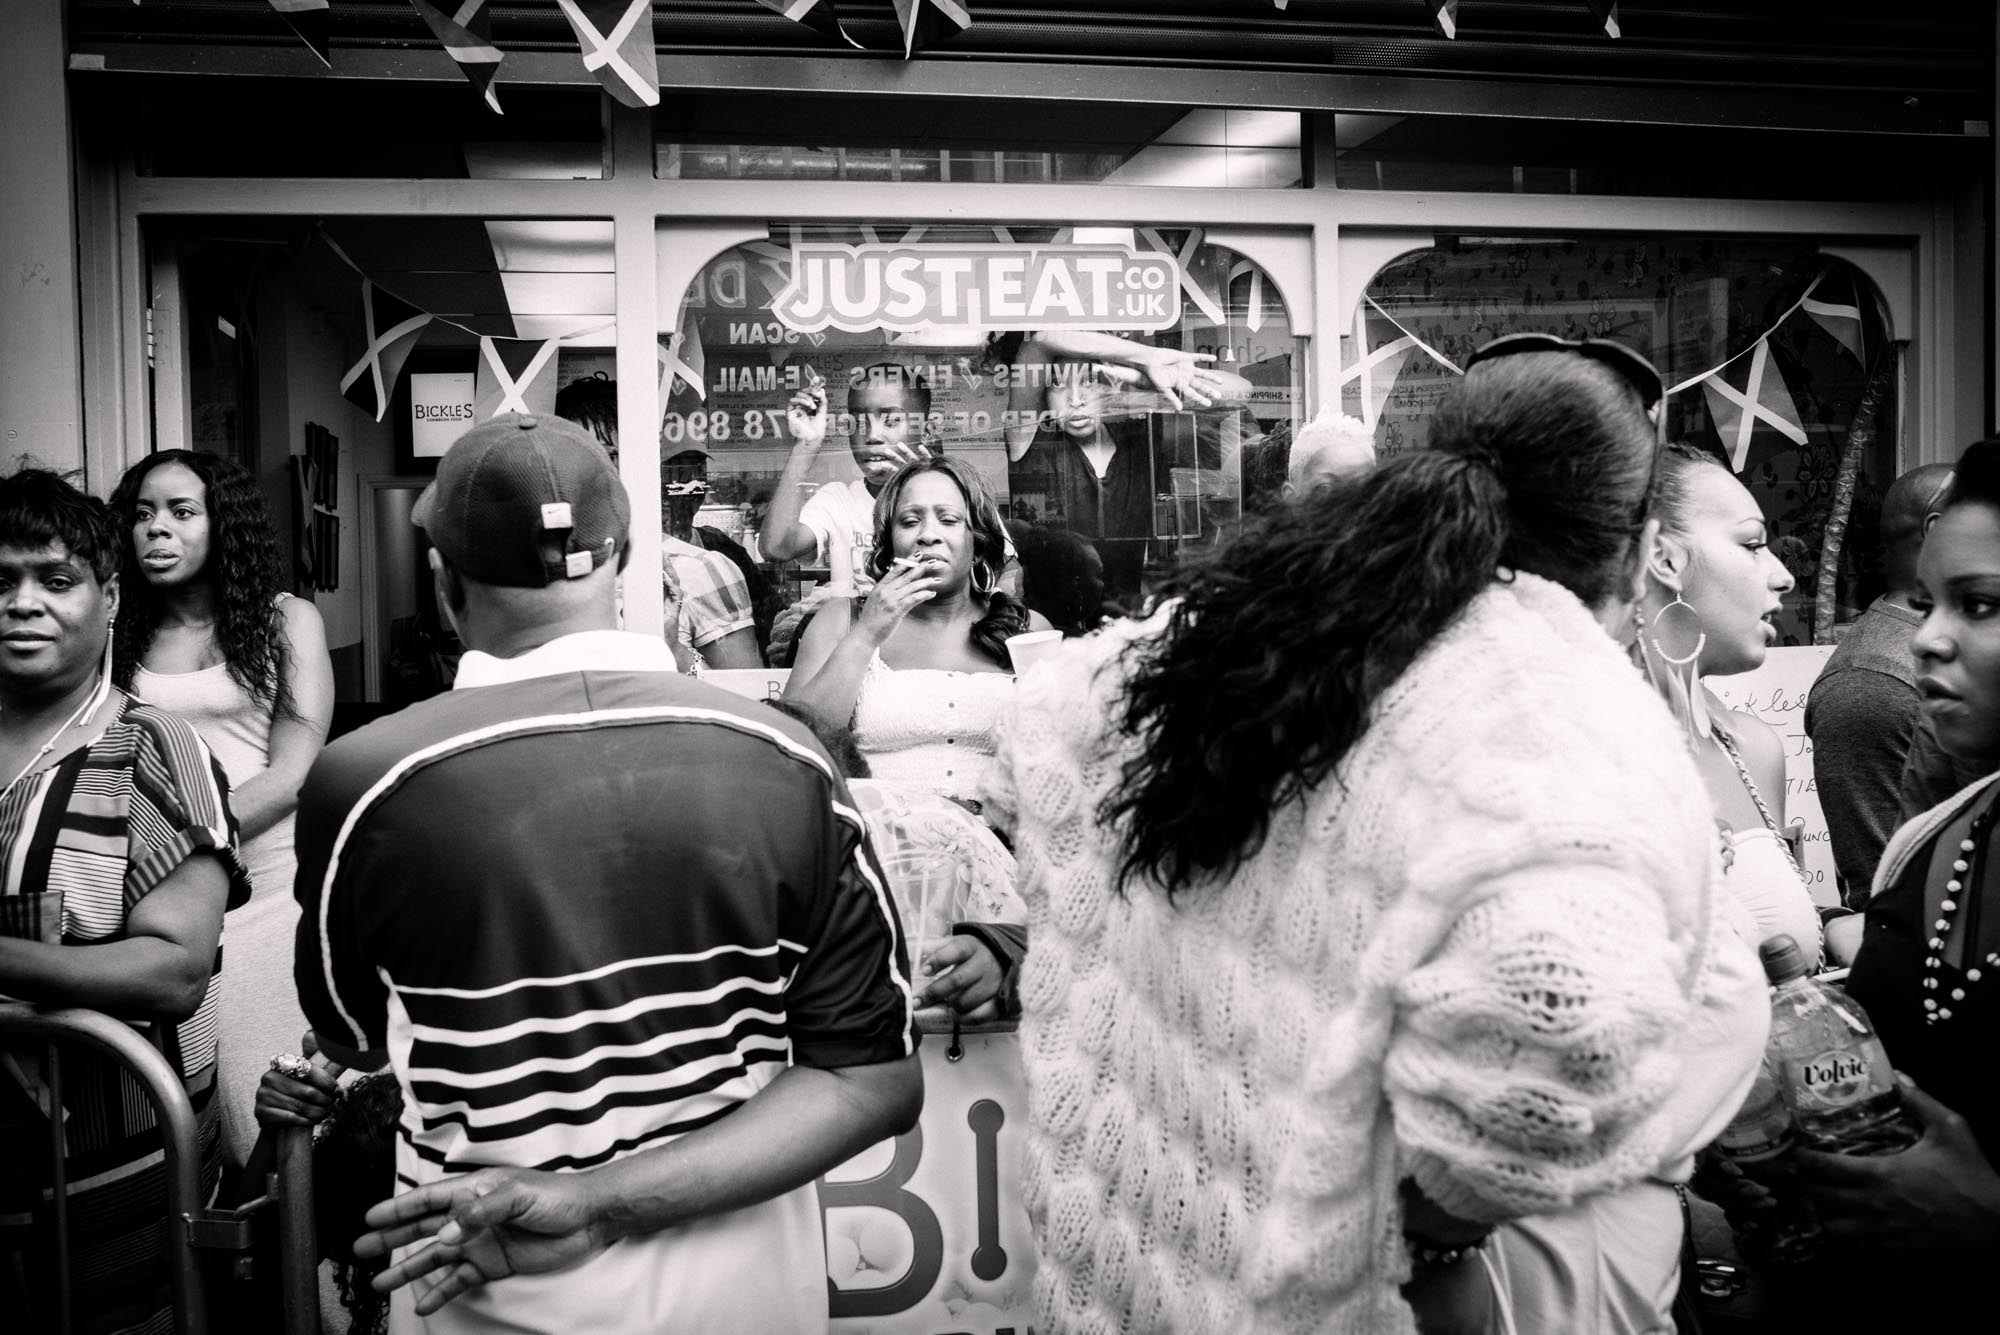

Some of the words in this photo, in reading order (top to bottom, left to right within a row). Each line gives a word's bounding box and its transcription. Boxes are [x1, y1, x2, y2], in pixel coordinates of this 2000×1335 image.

[790, 256, 971, 319] JUST
[988, 258, 1122, 317] EAT
[415, 403, 473, 419] BICKLES
[1804, 1057, 1868, 1086] Volvic
